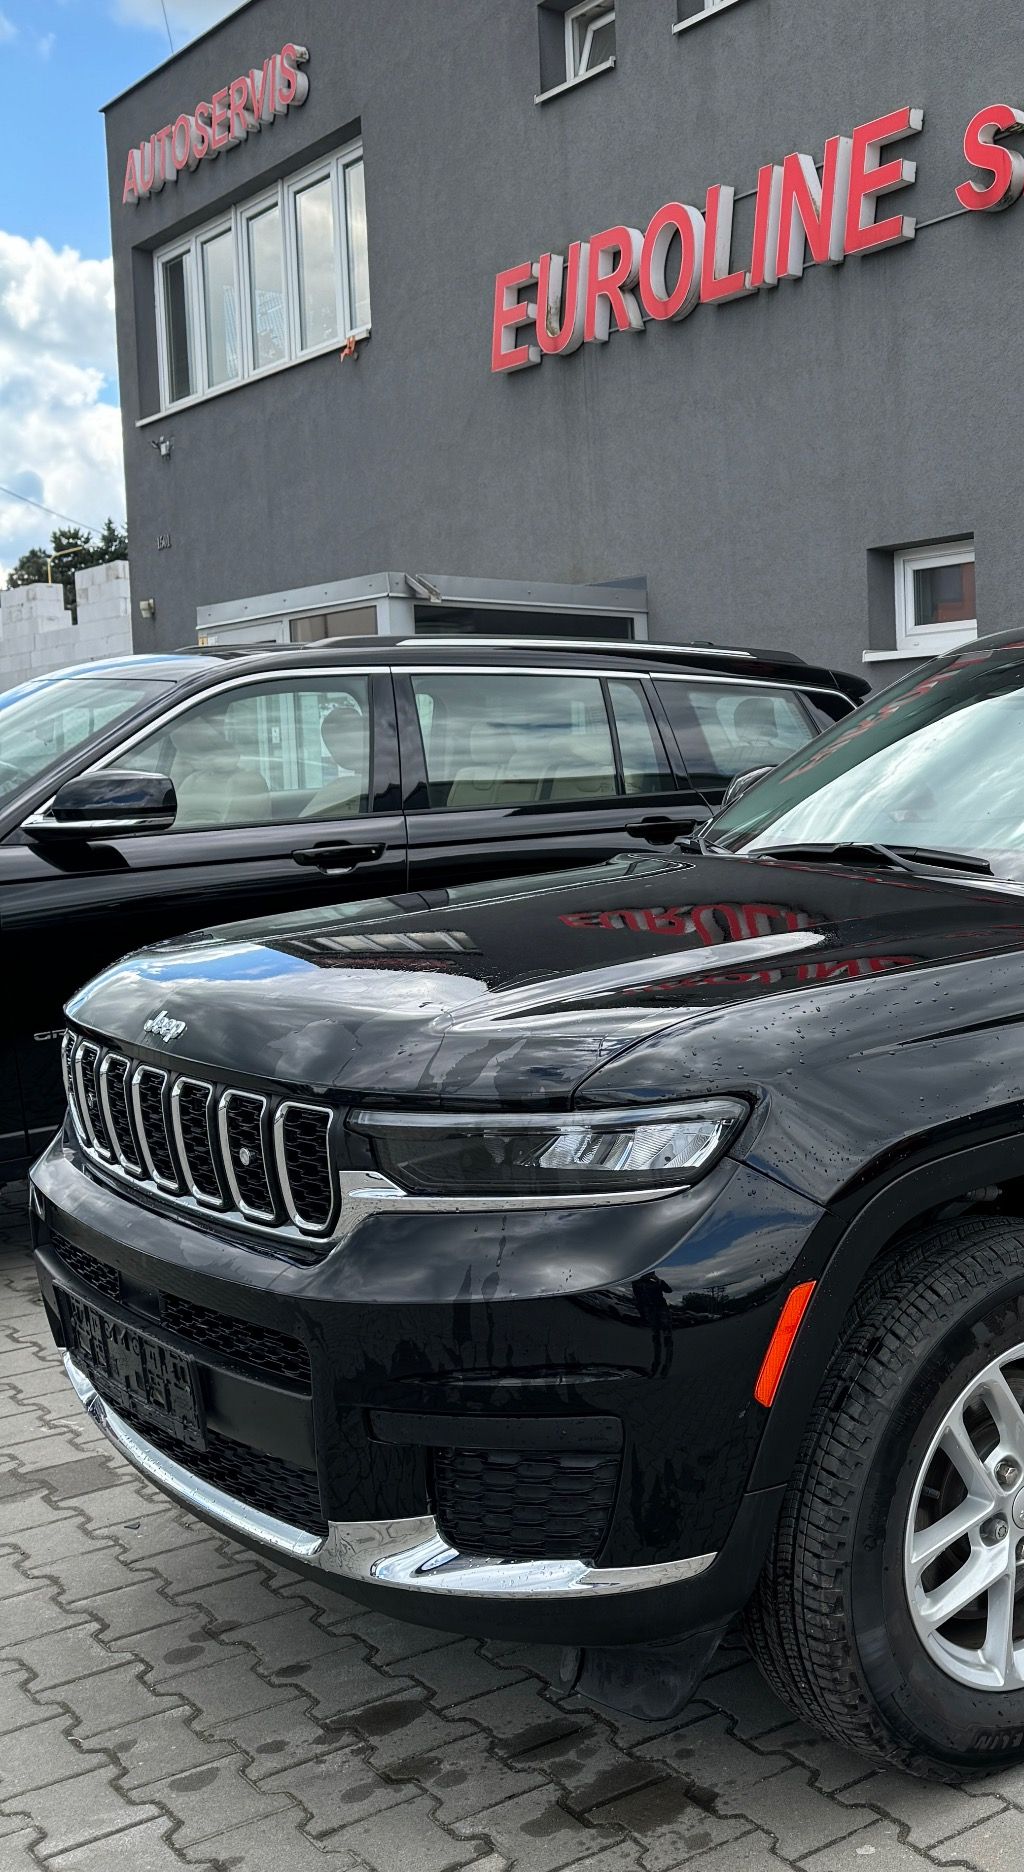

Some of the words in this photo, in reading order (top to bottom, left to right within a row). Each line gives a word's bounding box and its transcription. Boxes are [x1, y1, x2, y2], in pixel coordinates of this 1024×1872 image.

[122, 43, 309, 204] AUTOSERVIS
[491, 106, 922, 373] EUROLINE
[144, 1010, 187, 1042] Jeep
